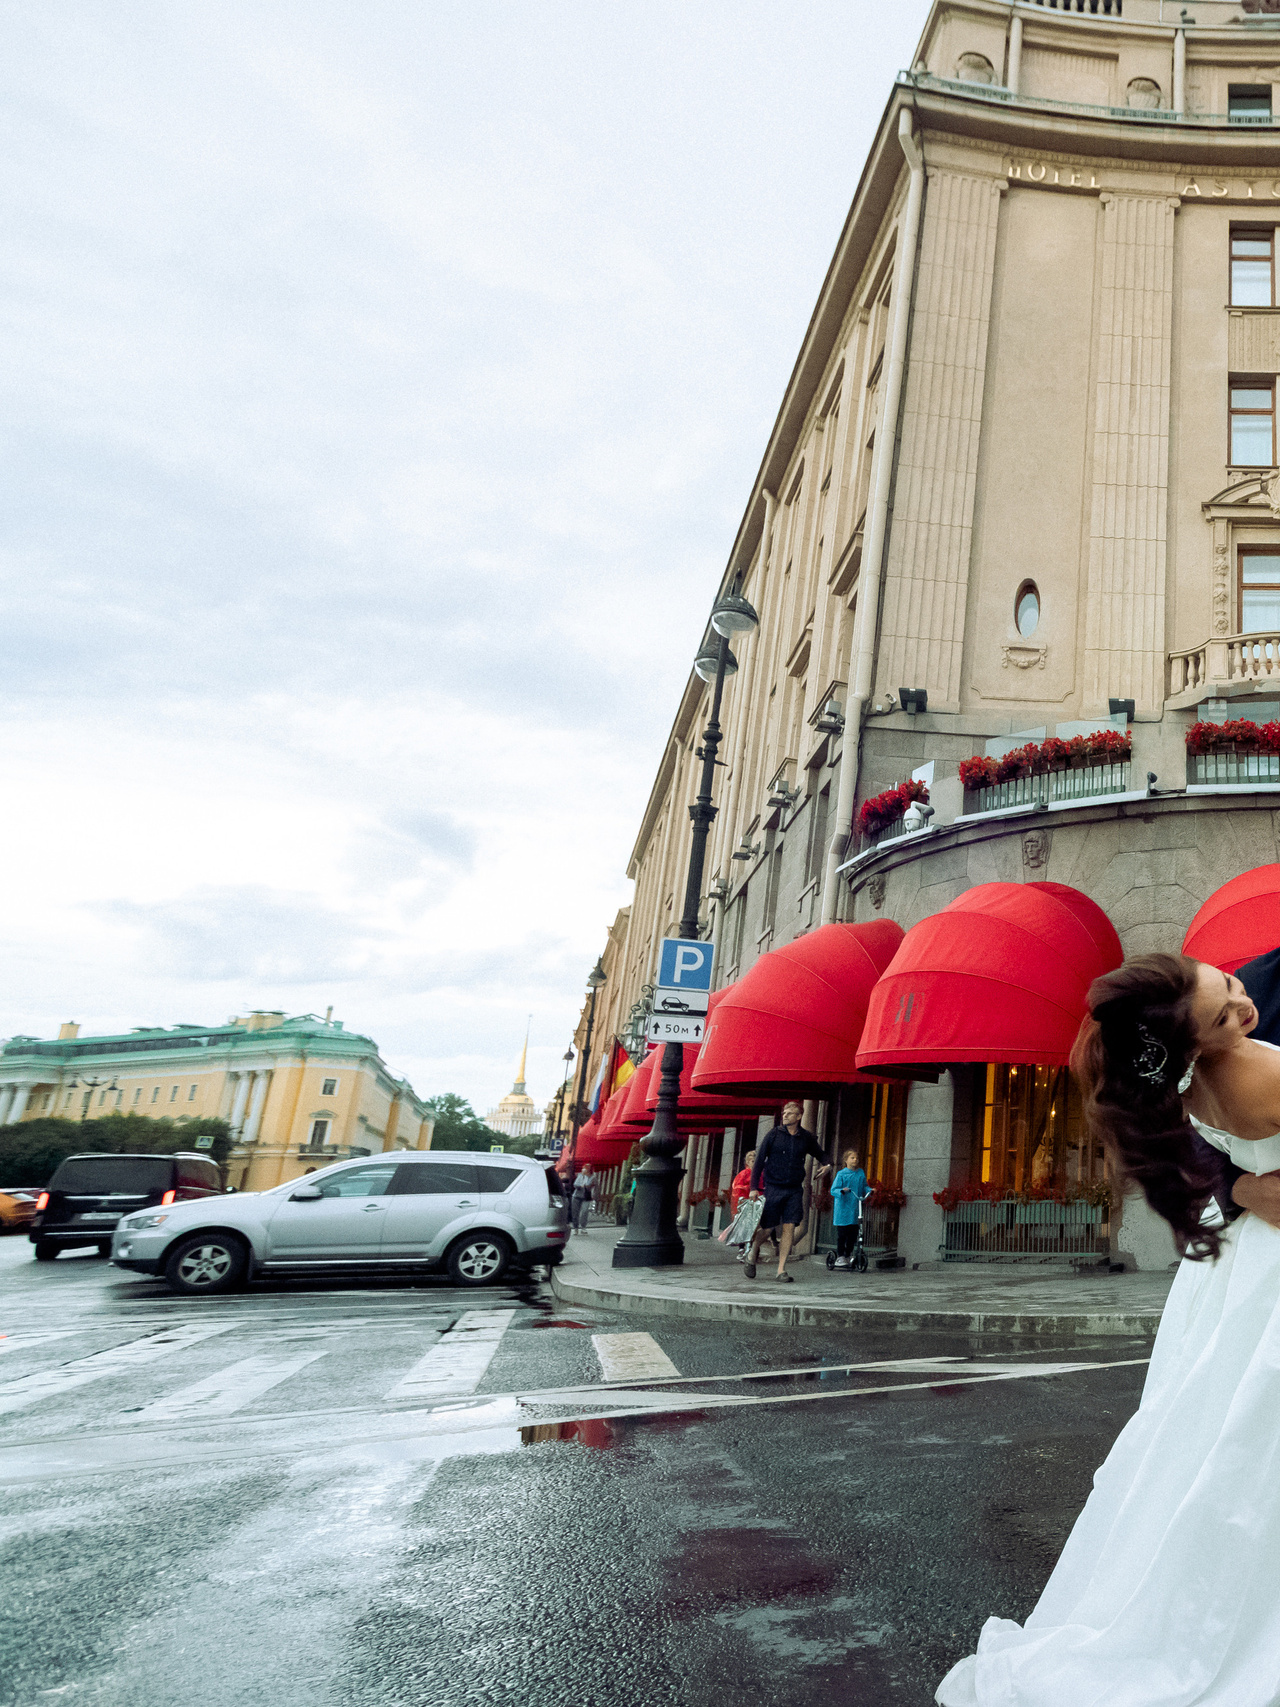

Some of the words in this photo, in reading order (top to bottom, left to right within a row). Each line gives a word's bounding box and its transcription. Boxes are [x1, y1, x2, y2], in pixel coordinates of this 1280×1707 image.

[1007, 162, 1101, 188] HOTEL
[673, 945, 705, 983] P
[553, 1139, 563, 1150] P
